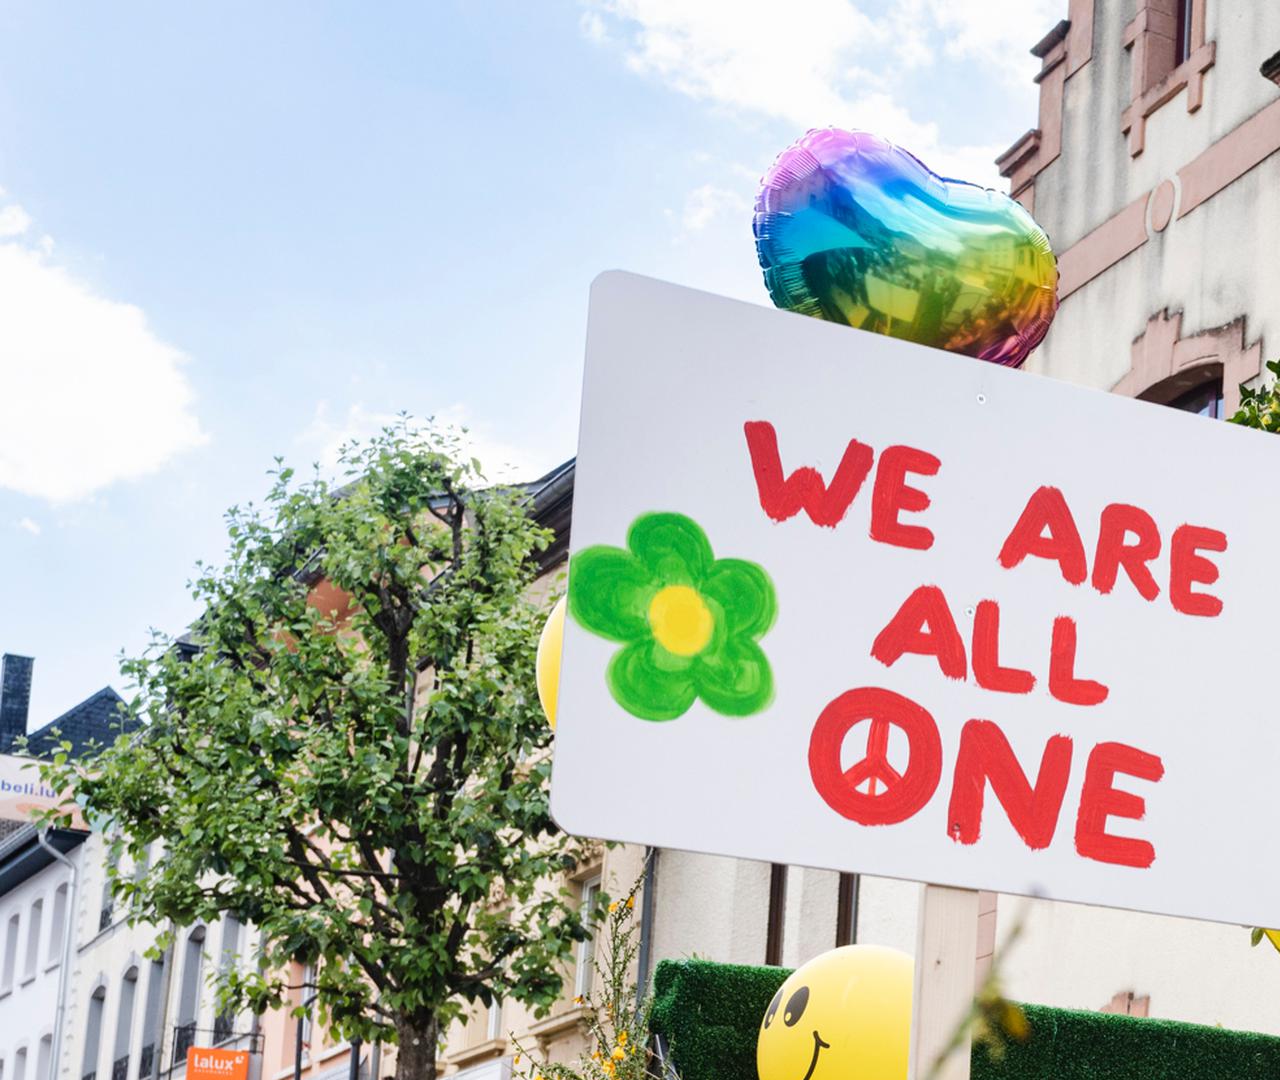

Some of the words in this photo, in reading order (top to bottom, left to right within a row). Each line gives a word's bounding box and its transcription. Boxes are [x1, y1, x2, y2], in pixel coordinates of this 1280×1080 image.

[744, 421, 941, 551] WE
[998, 485, 1228, 617] ARE
[870, 585, 1108, 706] ALL
[808, 686, 1165, 869] ONE
[194, 1054, 234, 1070] lalux
